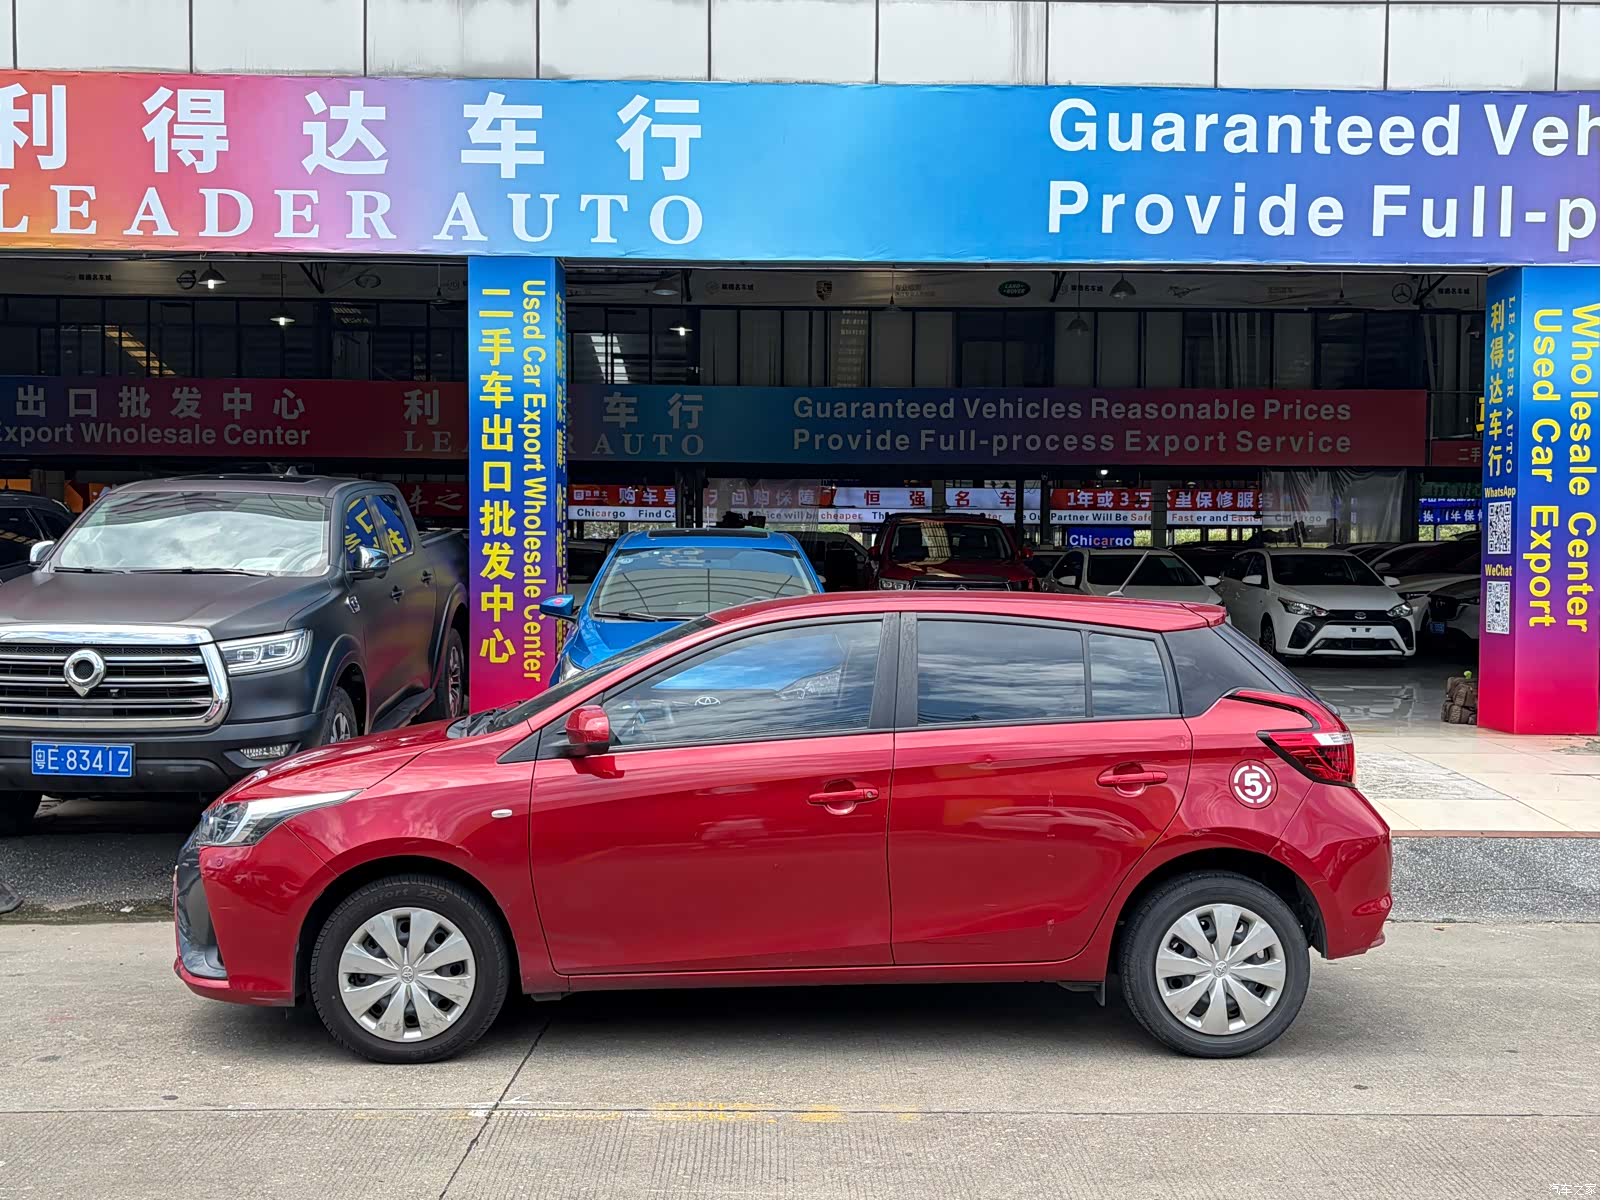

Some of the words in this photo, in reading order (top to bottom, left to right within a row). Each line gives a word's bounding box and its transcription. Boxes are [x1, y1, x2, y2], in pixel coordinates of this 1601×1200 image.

[0, 83, 703, 182] 利得达车行
[1048, 97, 1461, 157] Guaranteed
[0, 183, 397, 241] LEADER
[433, 190, 704, 246] AUTO
[1048, 179, 1346, 238] Provide
[1372, 184, 1598, 253] Full-p
[522, 280, 546, 339] Used
[523, 346, 547, 388] Car
[1506, 296, 1516, 398] LEADER
[1532, 308, 1563, 401] Used
[15, 384, 306, 421] 出口批发中心
[793, 396, 955, 420] Guaranteed
[963, 397, 1084, 422] Vehicles
[1090, 398, 1256, 421] Reasonable
[1263, 400, 1352, 422] Prices
[1488, 299, 1505, 476] 利得达车行
[1569, 303, 1600, 496] Wholesale
[0, 422, 74, 448] xport
[79, 422, 217, 446] Wholesale
[223, 424, 311, 448] Center
[518, 393, 547, 471] Export
[591, 434, 705, 456] AUTO
[793, 429, 911, 453] Provide
[919, 431, 1115, 457] Full-process
[1124, 430, 1228, 456] Export
[1236, 431, 1352, 454] Service
[1505, 407, 1514, 474] AUTO
[1531, 418, 1561, 483] Car
[478, 288, 517, 664] 二手车出口批发中心
[1484, 486, 1517, 499] WhatsApp
[523, 476, 547, 598] Wholesale
[576, 508, 626, 519] Chicargo
[638, 509, 662, 519] Find
[1051, 513, 1089, 521] Partner
[1092, 513, 1112, 521] Will
[1116, 513, 1128, 521] Be
[1209, 513, 1228, 522] and
[1484, 564, 1513, 577] WeChat
[1522, 505, 1559, 628] Export
[1566, 511, 1597, 633] Center
[523, 604, 547, 682] Center
[1243, 772, 1263, 797] 5
